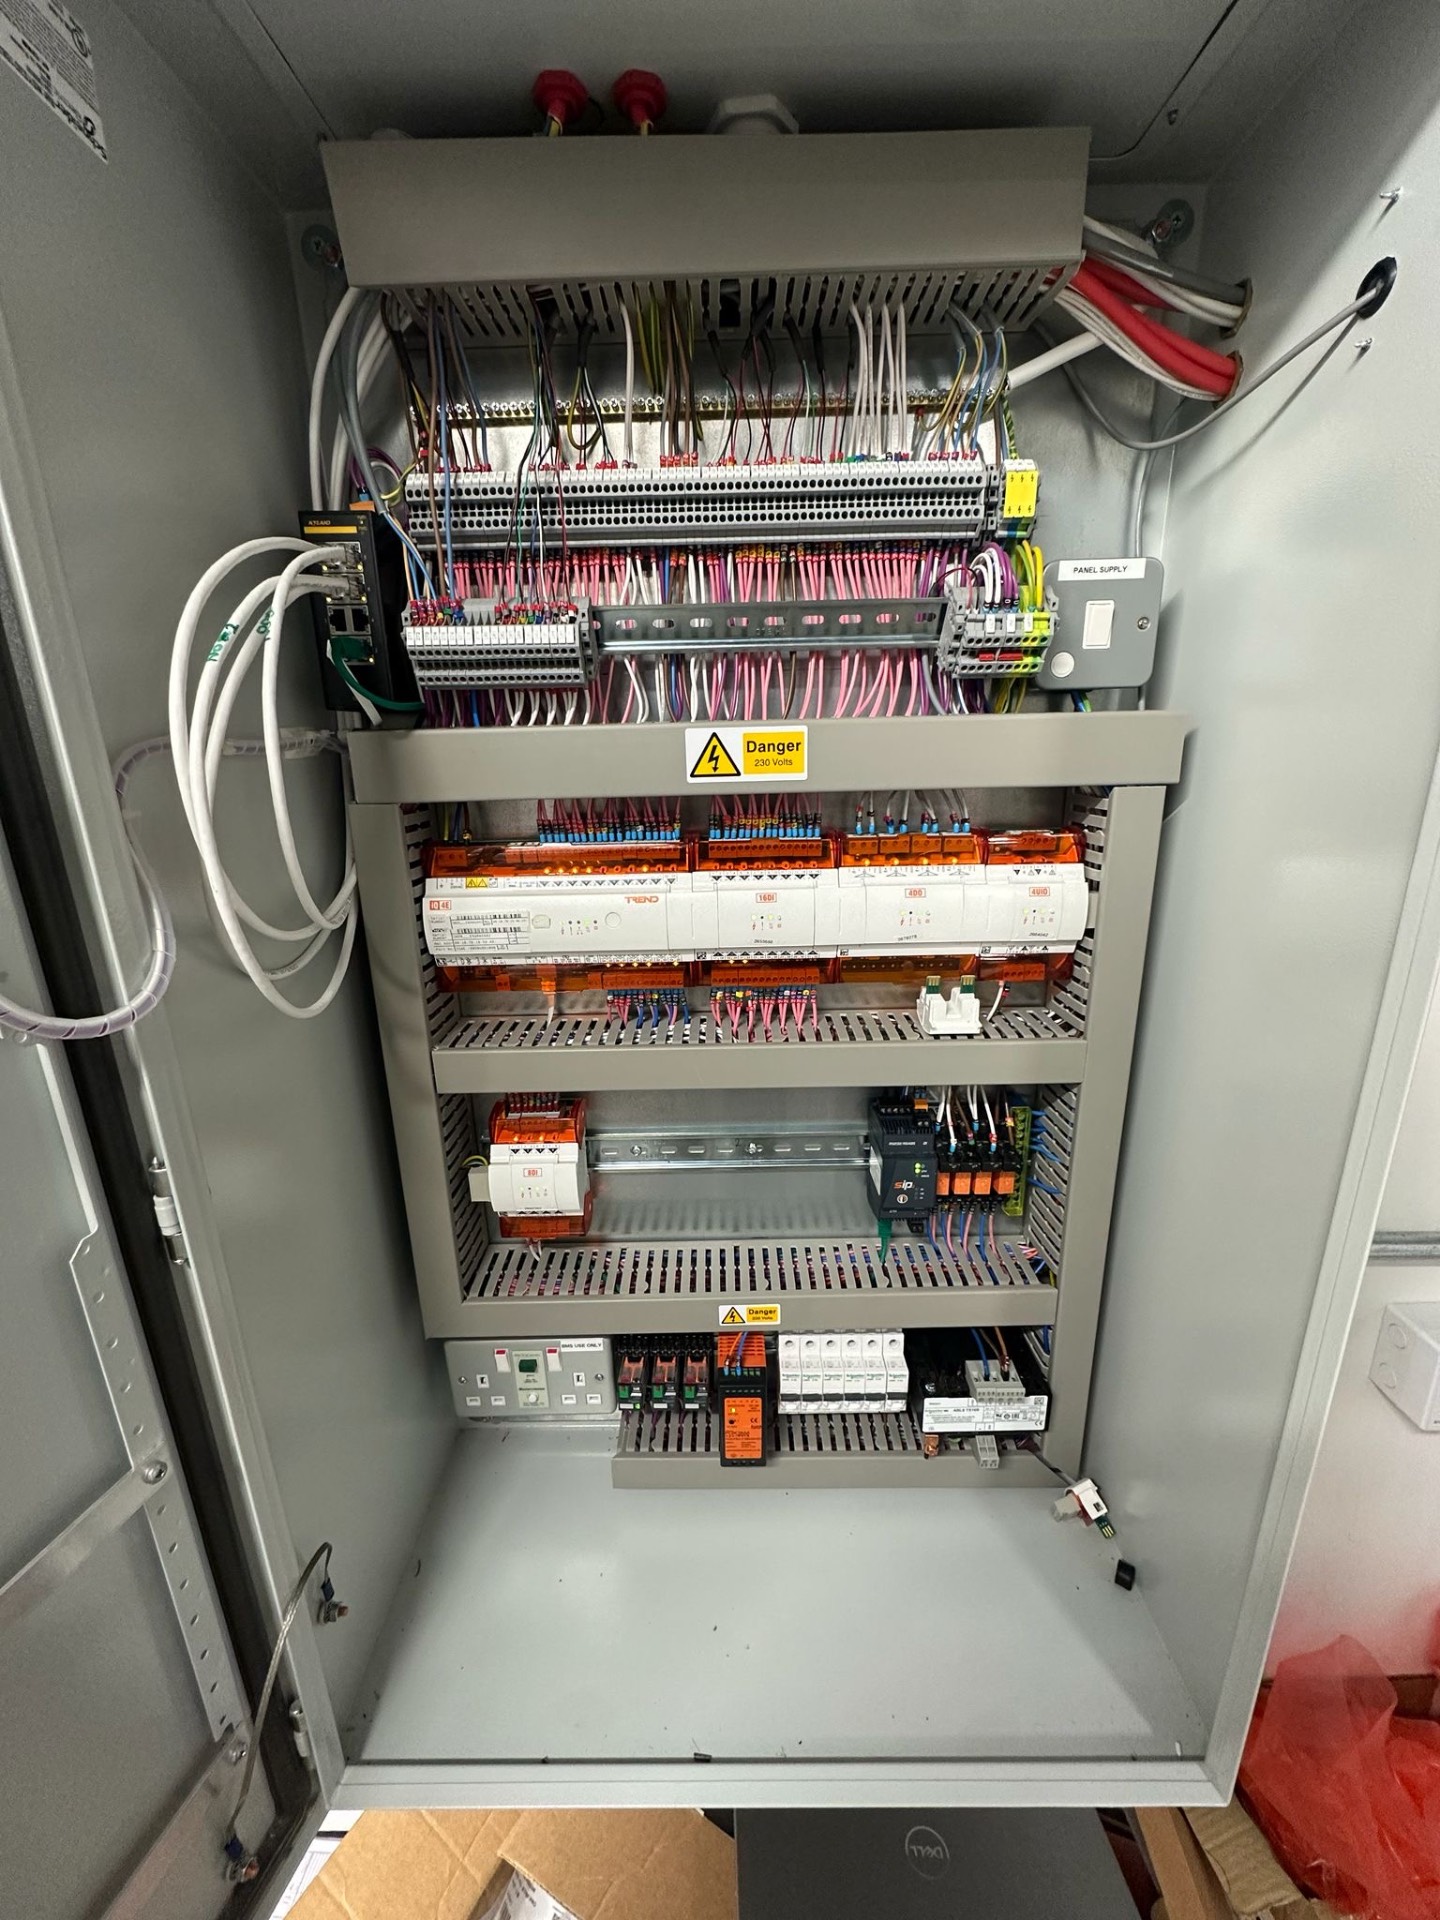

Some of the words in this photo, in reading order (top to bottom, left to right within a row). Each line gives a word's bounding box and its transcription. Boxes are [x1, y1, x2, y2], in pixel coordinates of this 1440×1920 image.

[1073, 566, 1098, 574] PANEL
[1099, 565, 1128, 573] SUPPLY
[746, 740, 802, 755] Danger
[754, 758, 771, 767] 230
[772, 758, 793, 766] Volts
[625, 895, 659, 904] TREND
[894, 1179, 914, 1190] sip
[748, 1308, 777, 1316] Danger
